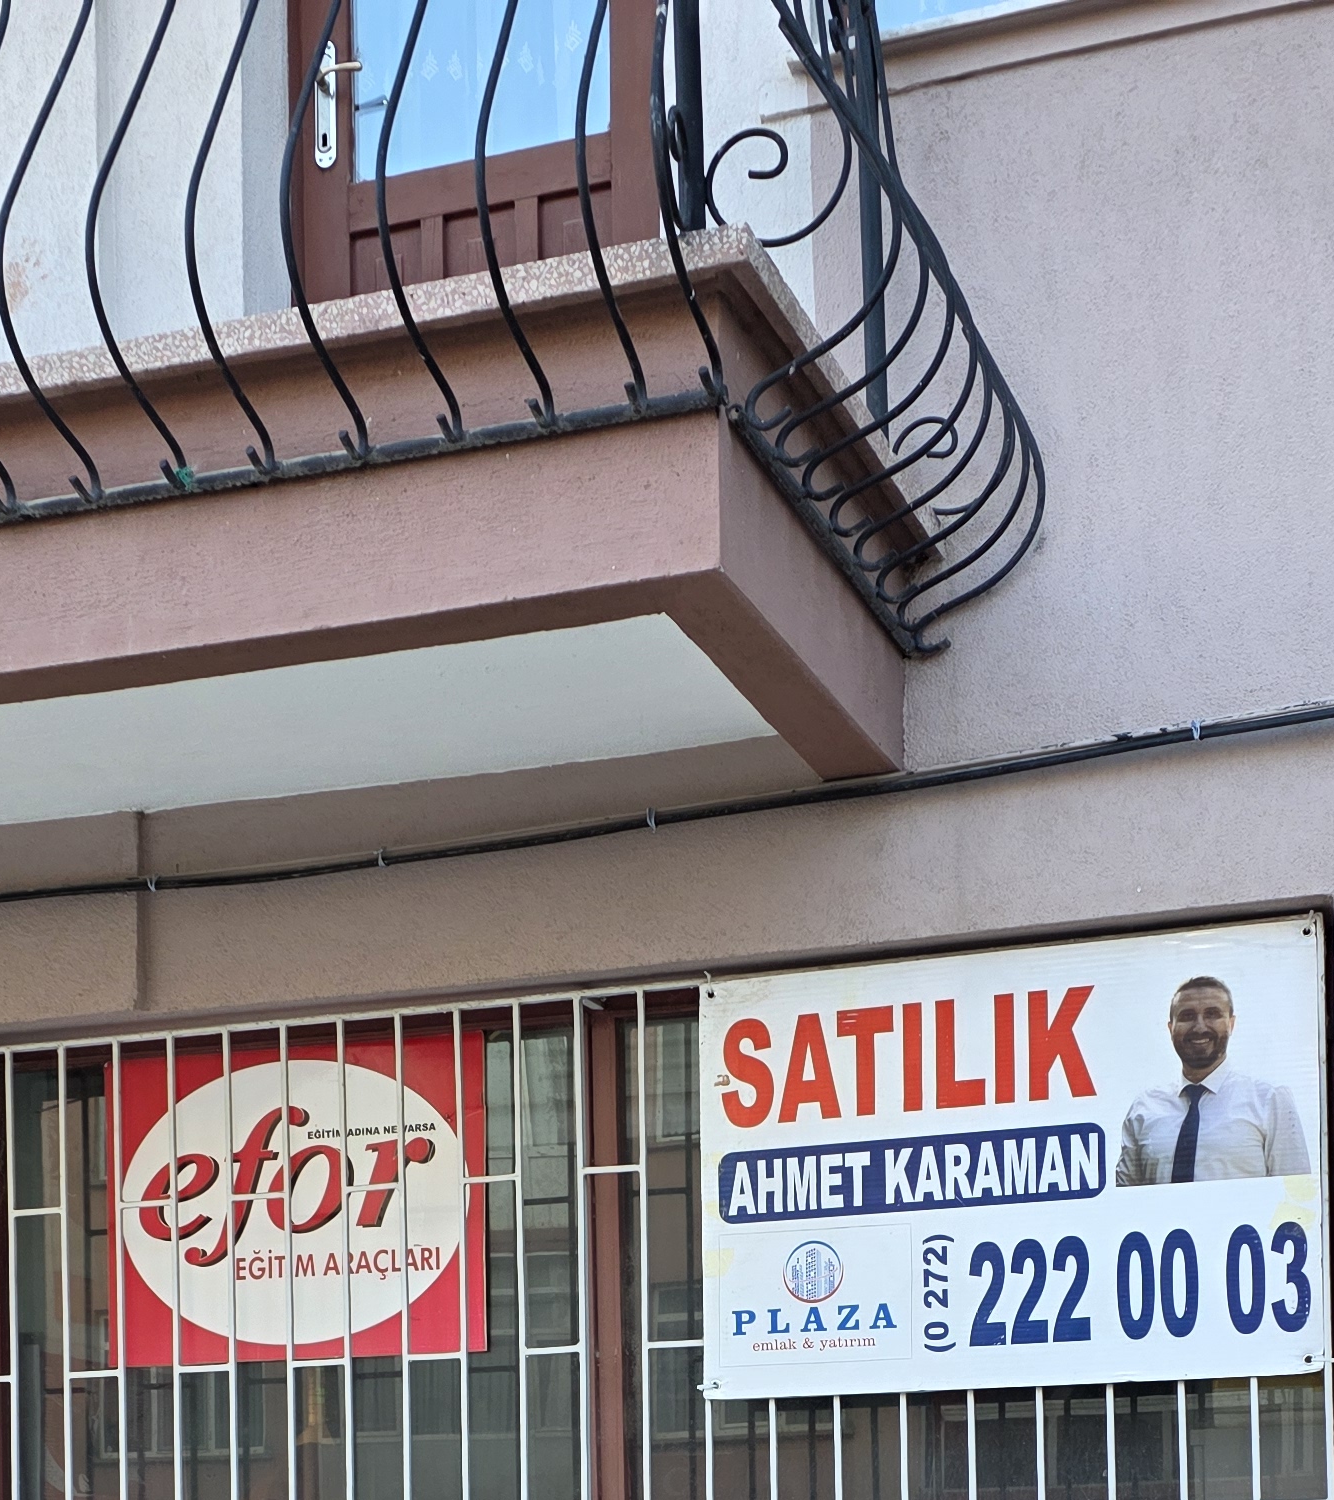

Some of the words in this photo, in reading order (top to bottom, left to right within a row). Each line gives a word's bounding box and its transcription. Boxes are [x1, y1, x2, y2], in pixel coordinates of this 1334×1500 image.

[721, 985, 1097, 1128] SATILIK
[347, 1127, 380, 1137] ADINA
[383, 1125, 398, 1134] NE
[138, 1105, 436, 1268] efor
[728, 1151, 871, 1216] AHMET
[884, 1132, 1099, 1205] KARAMAN
[236, 1250, 316, 1280] EĞİTM
[922, 1234, 955, 1309] 272)
[969, 1235, 1092, 1346] 222
[1116, 1228, 1199, 1339] 00
[1226, 1221, 1312, 1334] 03
[732, 1303, 897, 1336] PLAZA
[752, 1338, 797, 1352] emlak
[802, 1336, 815, 1350] &
[819, 1336, 876, 1351] yatırım
[923, 1320, 956, 1353] (0
